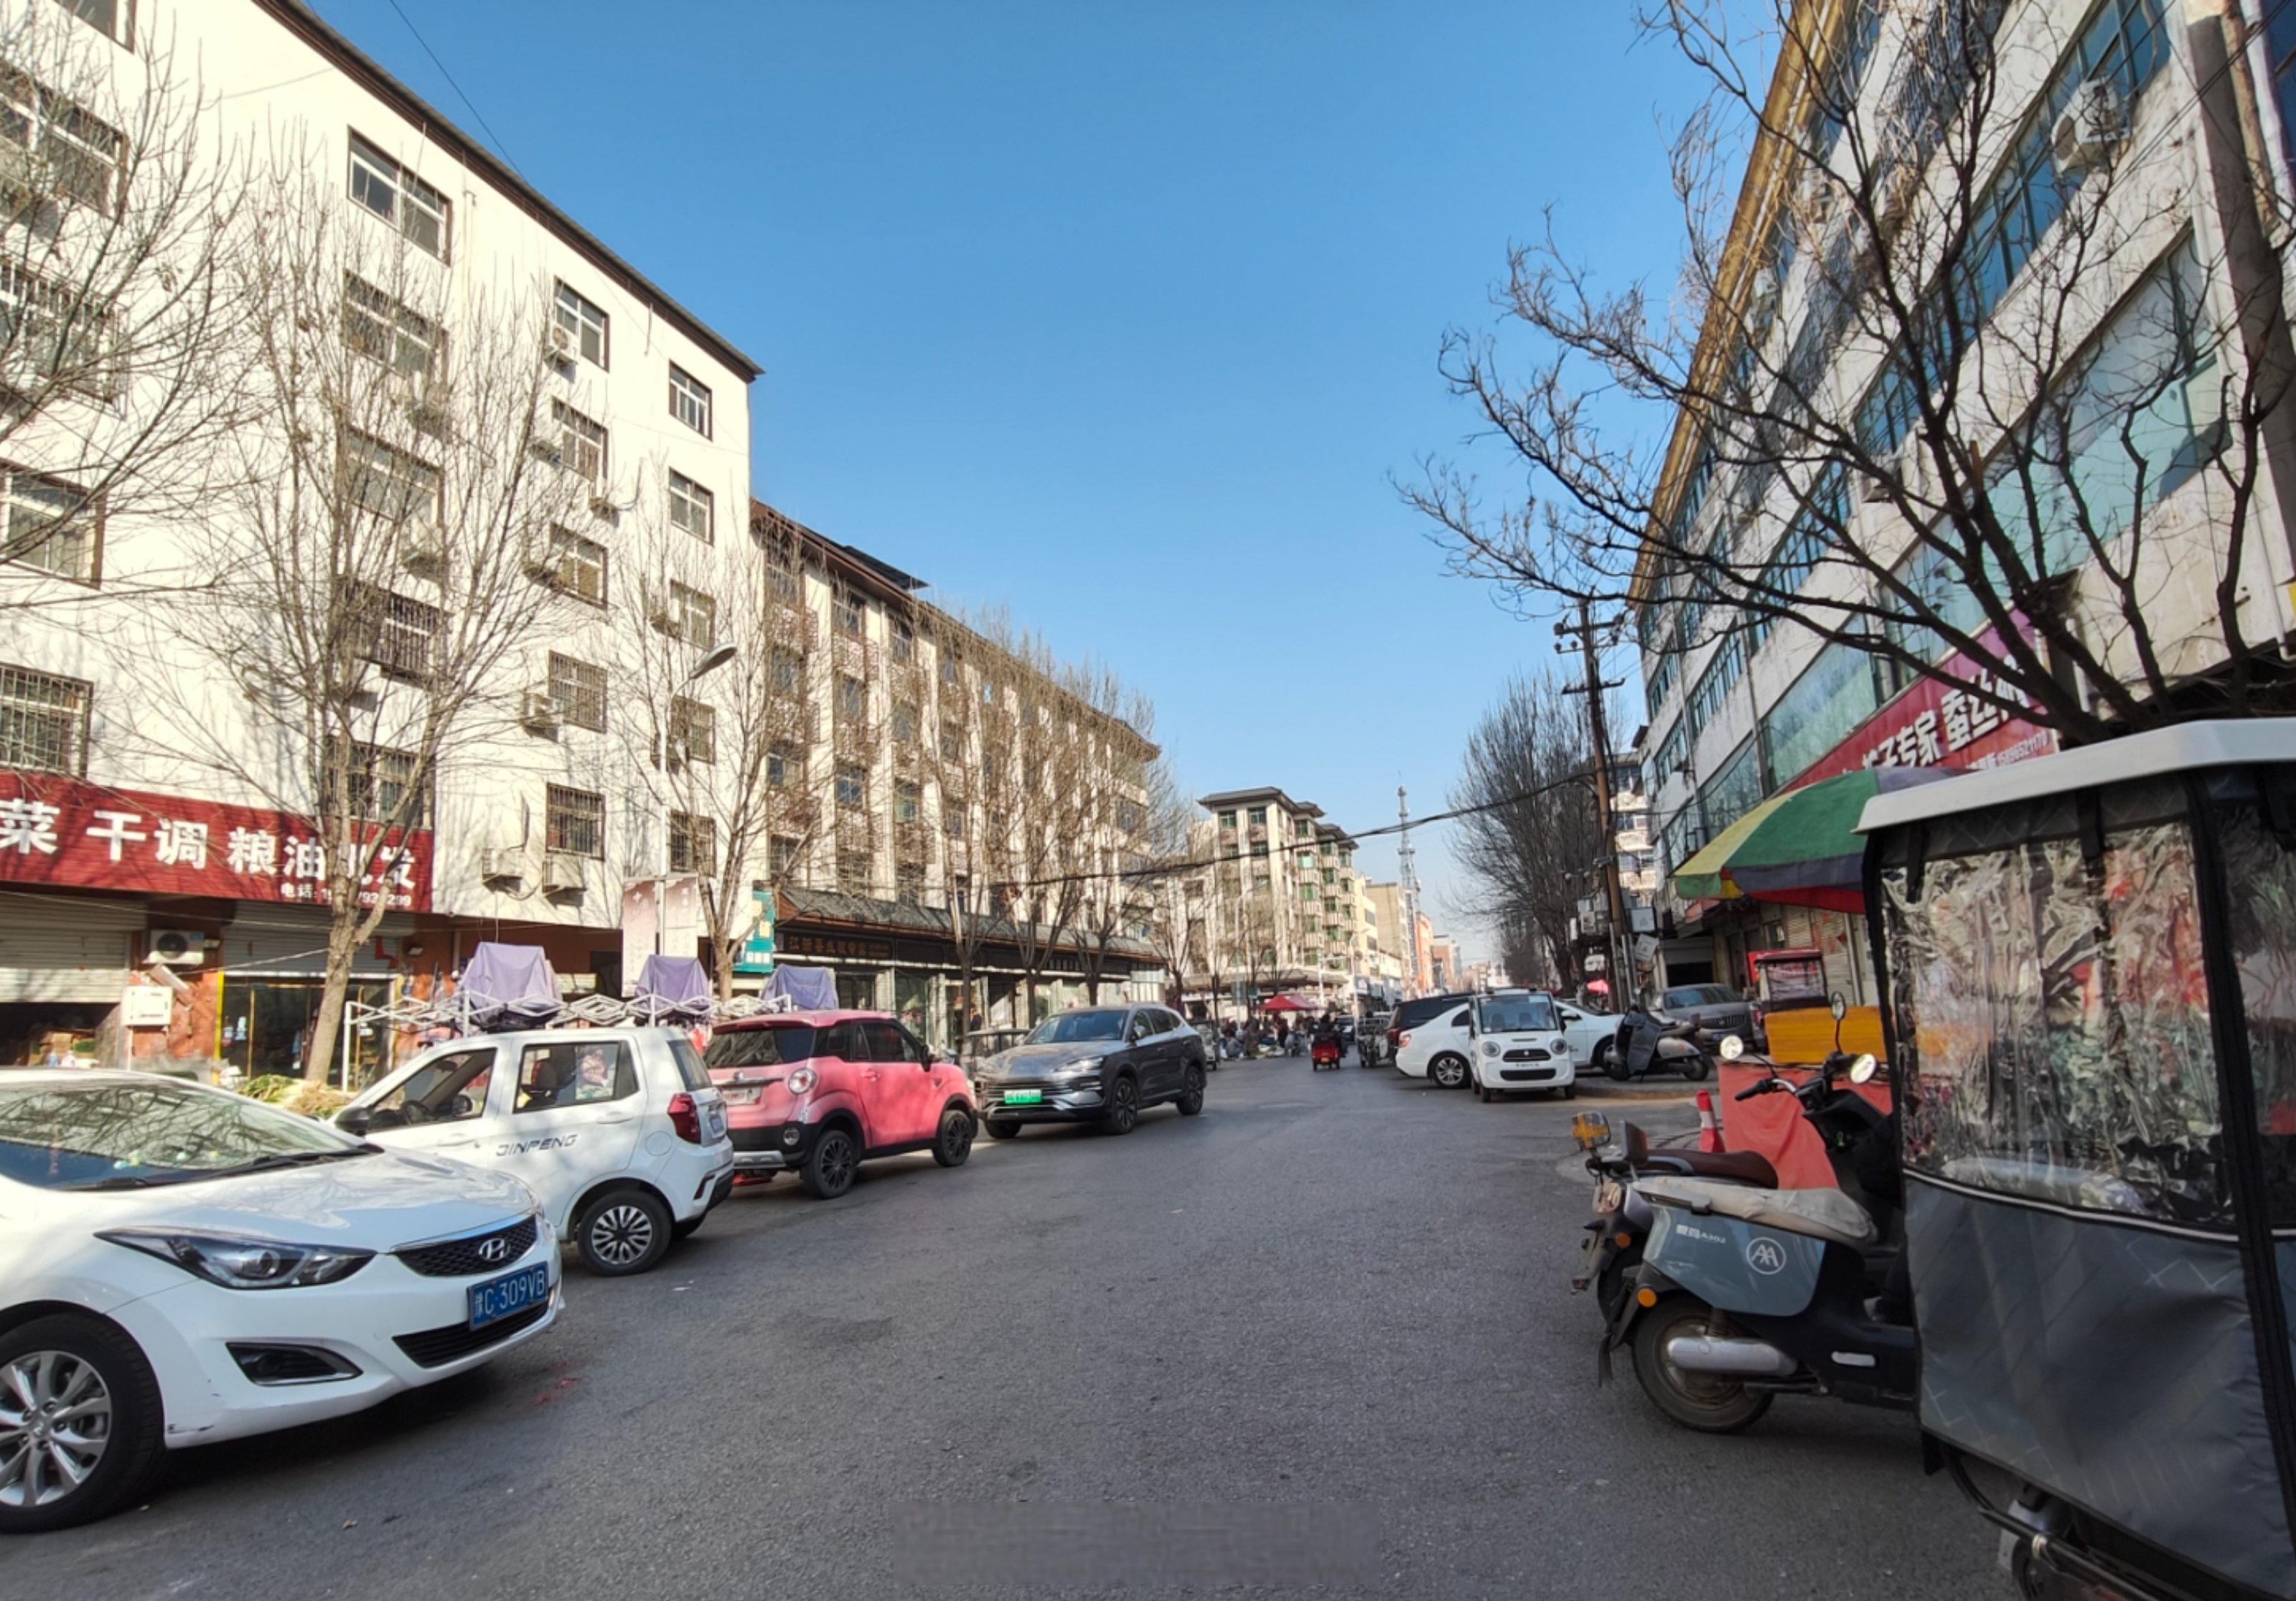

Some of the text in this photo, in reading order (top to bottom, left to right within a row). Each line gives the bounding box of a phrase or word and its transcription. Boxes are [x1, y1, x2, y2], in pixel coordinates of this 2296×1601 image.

[0, 798, 60, 854] 菜
[85, 810, 208, 869] 干调
[496, 1134, 578, 1157] JINPENG
